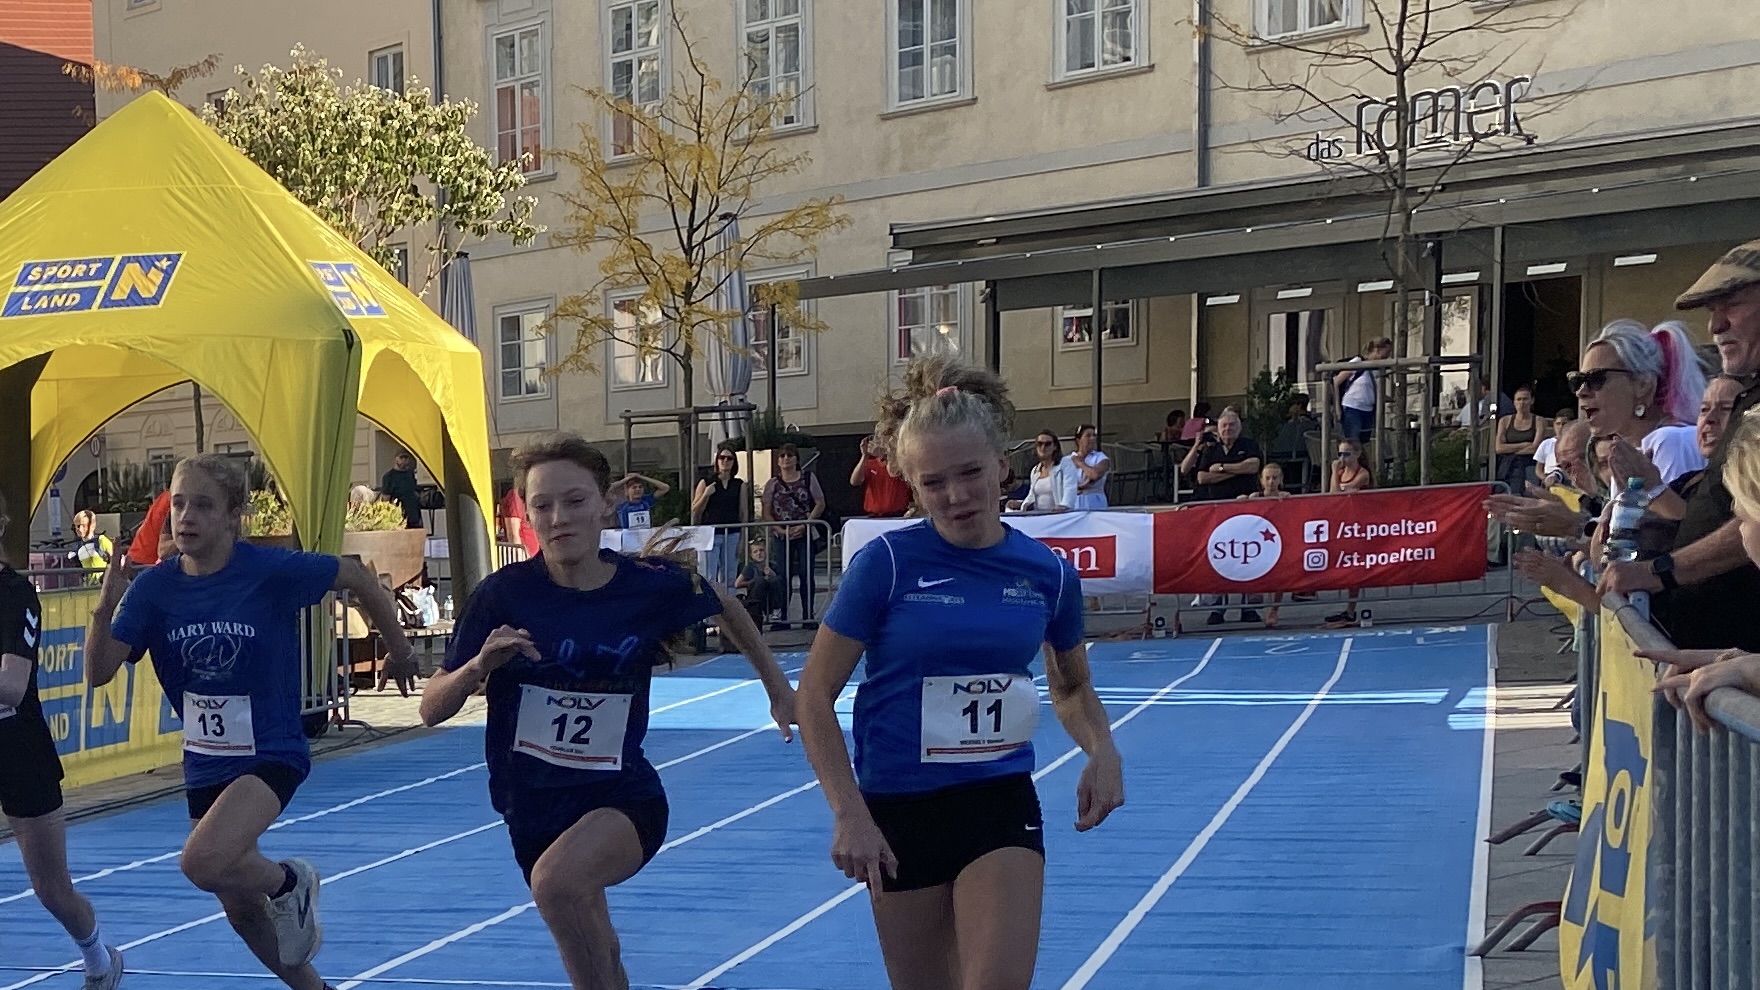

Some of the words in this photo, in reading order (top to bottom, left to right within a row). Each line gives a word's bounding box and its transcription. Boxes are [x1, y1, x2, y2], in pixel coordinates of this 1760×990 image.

[1307, 132, 1343, 161] das
[28, 262, 102, 281] SPORT
[21, 293, 81, 311] LAND
[1337, 519, 1438, 540] /st.poelten
[1213, 537, 1262, 565] stp
[1335, 546, 1436, 569] /st.poelten
[212, 621, 256, 638] WARD
[198, 712, 226, 737] 13
[961, 698, 1003, 734] 11
[551, 713, 594, 745] 12
